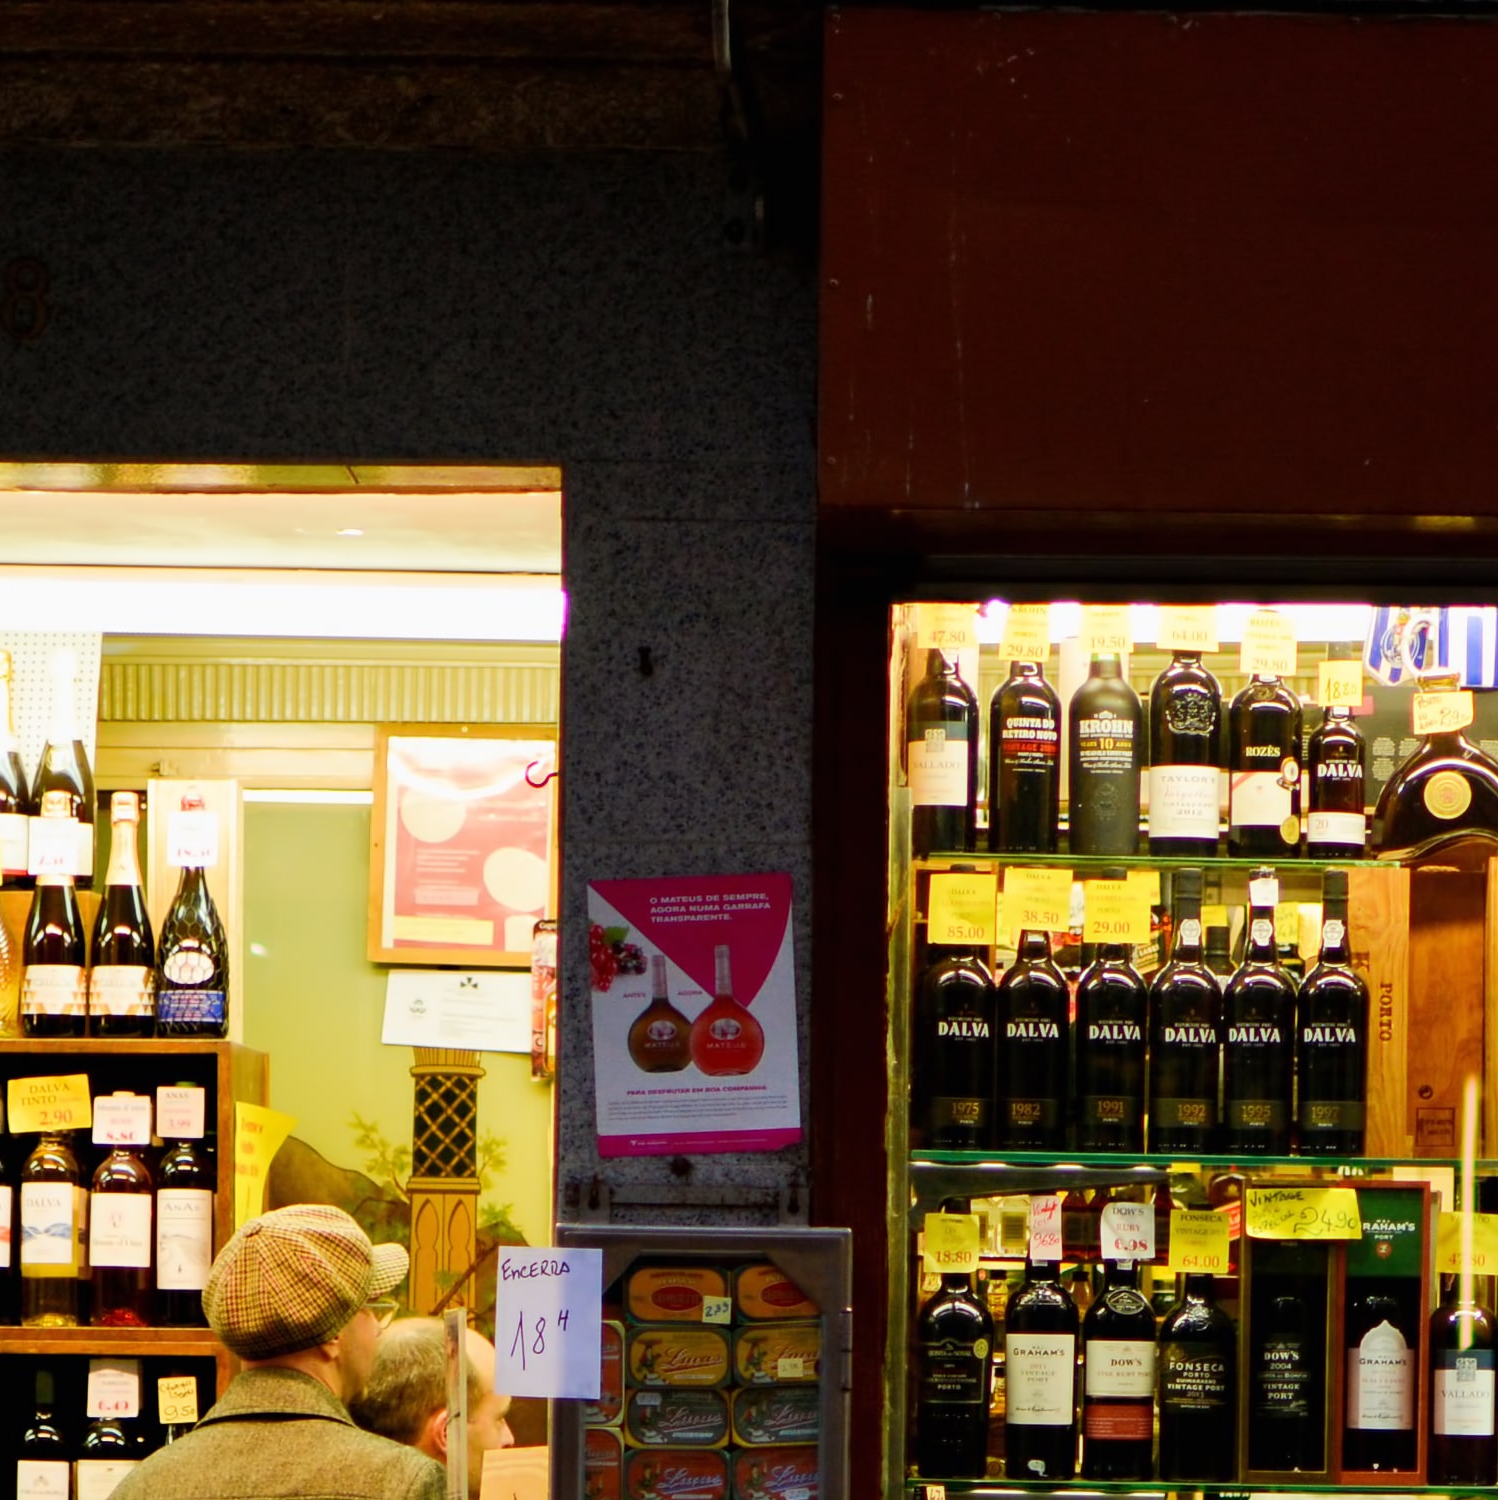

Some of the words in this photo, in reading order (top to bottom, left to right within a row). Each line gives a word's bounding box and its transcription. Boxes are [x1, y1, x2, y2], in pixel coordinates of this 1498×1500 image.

[1007, 644, 1043, 658] 29.80
[1079, 719, 1133, 734] KROHN
[1317, 763, 1363, 779] DALVA
[650, 897, 658, 905] O
[661, 895, 703, 904] MATEUS
[706, 894, 720, 902] DE
[650, 905, 686, 914] AGORA
[689, 904, 720, 912] NUMA
[723, 902, 771, 911] GARRAFA
[651, 913, 733, 924] TRANSPARENTE.
[1022, 909, 1060, 925] 38.50
[947, 926, 985, 940] 85.00
[1093, 921, 1130, 935] 29.00
[1379, 980, 1394, 1042] PORTO
[938, 1021, 991, 1039] DALVA
[1006, 1022, 1060, 1040] DALVA
[1089, 1024, 1142, 1042] DALVA
[1165, 1027, 1217, 1045] DALVA
[1228, 1026, 1282, 1044] DALVA
[1303, 1026, 1357, 1044] DALVA
[29, 1083, 71, 1095] DALVA
[20, 1095, 57, 1106] TINTO
[1097, 1100, 1125, 1114] 1991
[951, 1102, 980, 1116] 1975
[1011, 1102, 1041, 1117] 1982
[1241, 1104, 1271, 1119] 1995
[39, 1109, 73, 1126] 2.90
[26, 1198, 62, 1209] DALVA
[935, 1250, 973, 1264] 18.80
[1182, 1255, 1221, 1269] 64.00
[1013, 1347, 1065, 1358] GRAHAM'S
[1264, 1350, 1300, 1361] DOW'S
[1169, 1362, 1225, 1373] FONSECA
